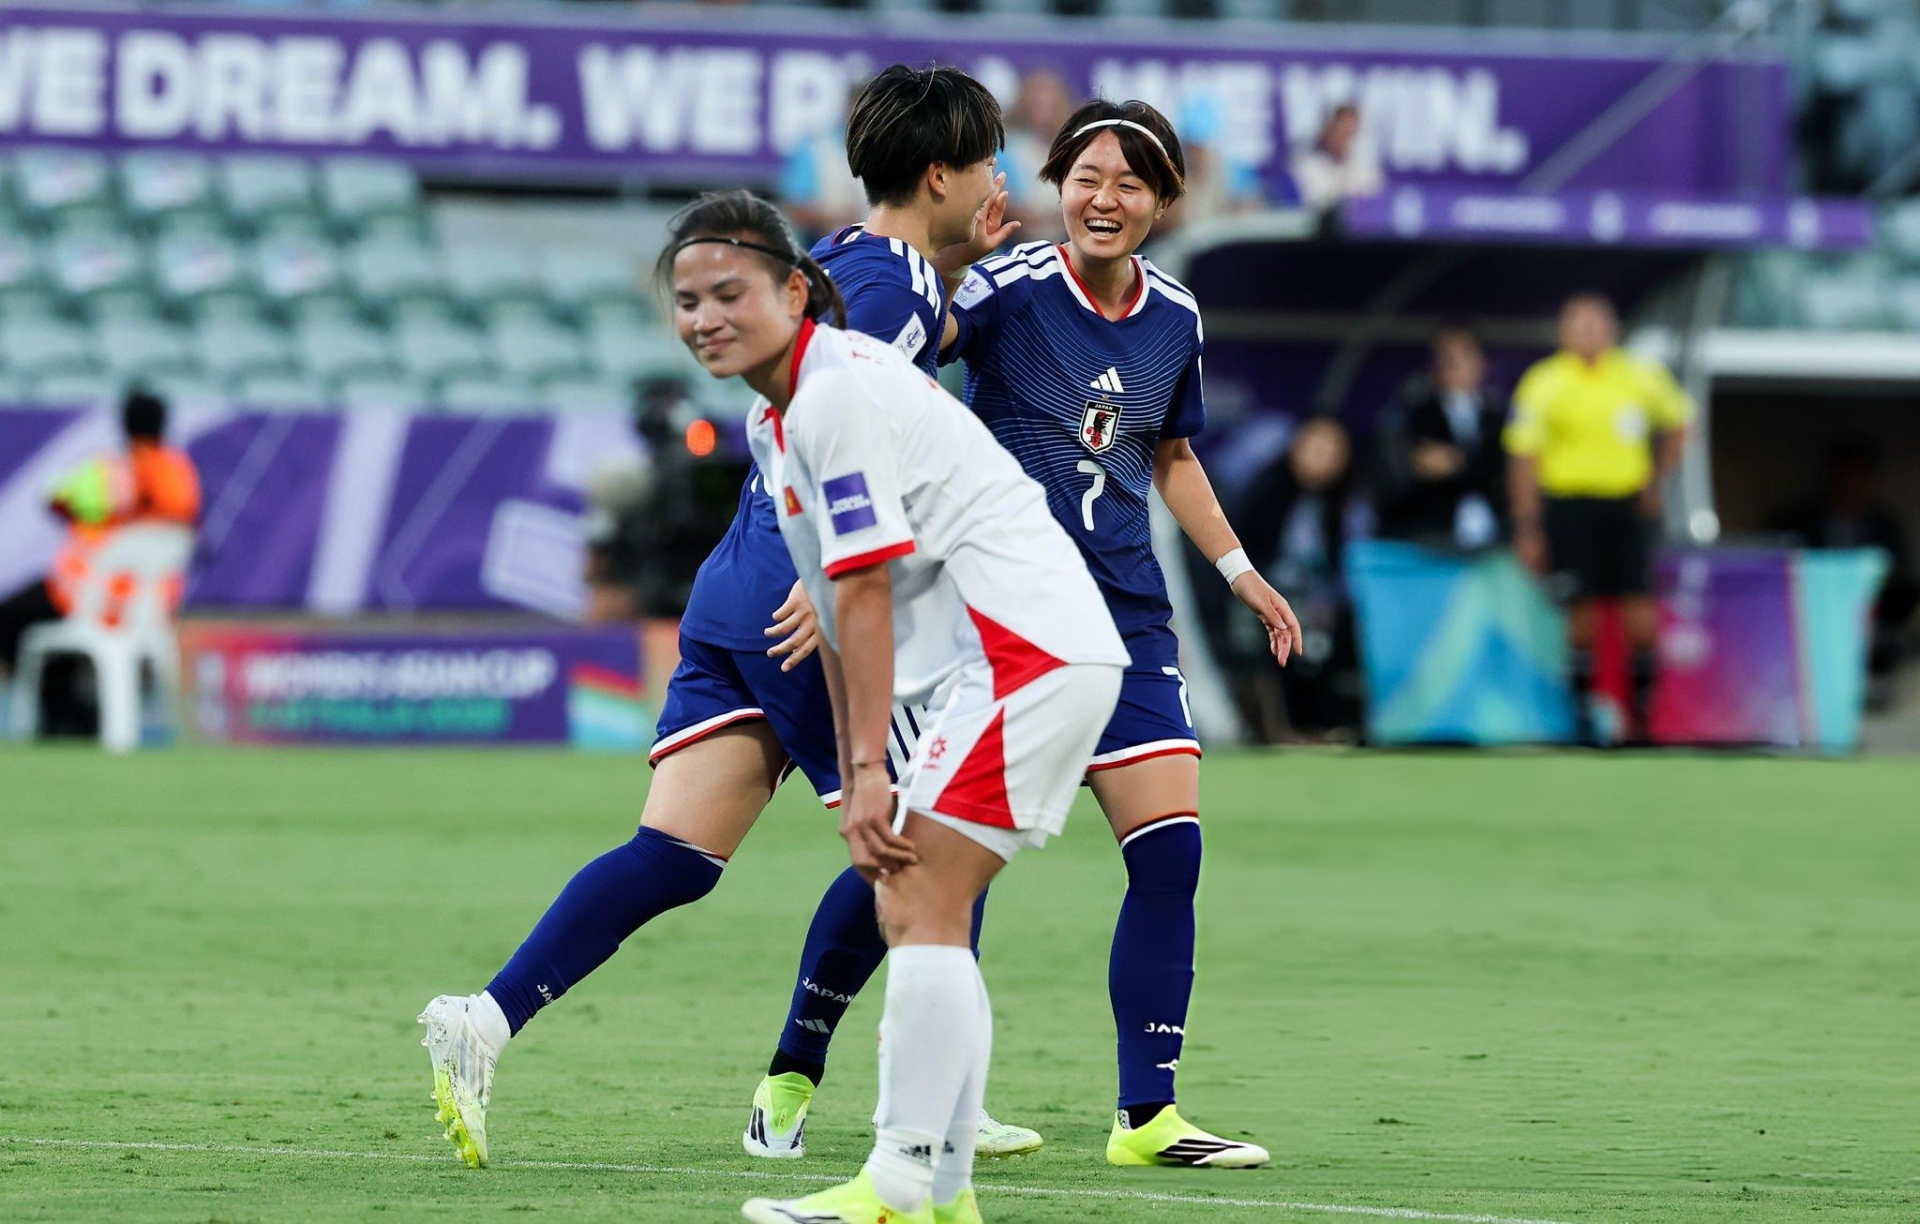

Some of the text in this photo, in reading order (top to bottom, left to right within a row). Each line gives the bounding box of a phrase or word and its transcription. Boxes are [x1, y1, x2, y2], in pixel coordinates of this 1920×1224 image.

[116, 31, 562, 149] DREAM.
[578, 43, 763, 153] WE
[1077, 460, 1106, 531] 7
[1161, 666, 1193, 728] 7
[803, 977, 854, 1003] JAPAN
